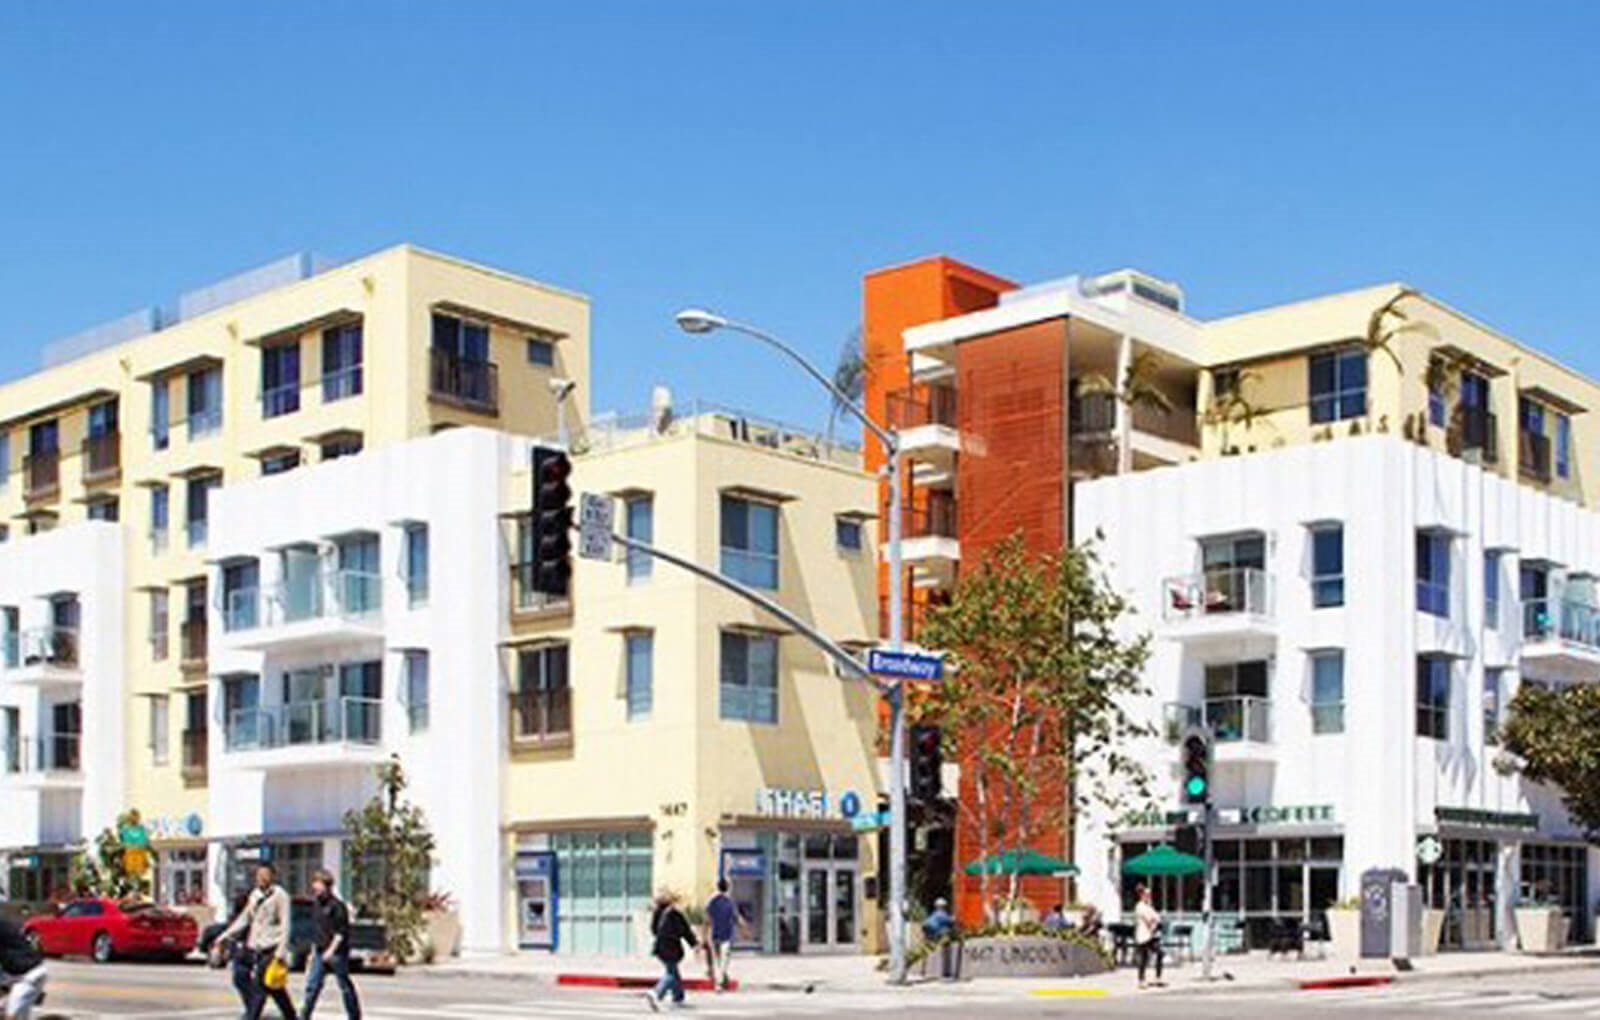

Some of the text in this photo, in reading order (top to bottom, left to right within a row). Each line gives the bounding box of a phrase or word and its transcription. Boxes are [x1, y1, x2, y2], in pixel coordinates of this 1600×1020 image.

[872, 652, 937, 679] Broadway
[754, 788, 838, 818] CHAS
[1250, 804, 1336, 825] COFFEE
